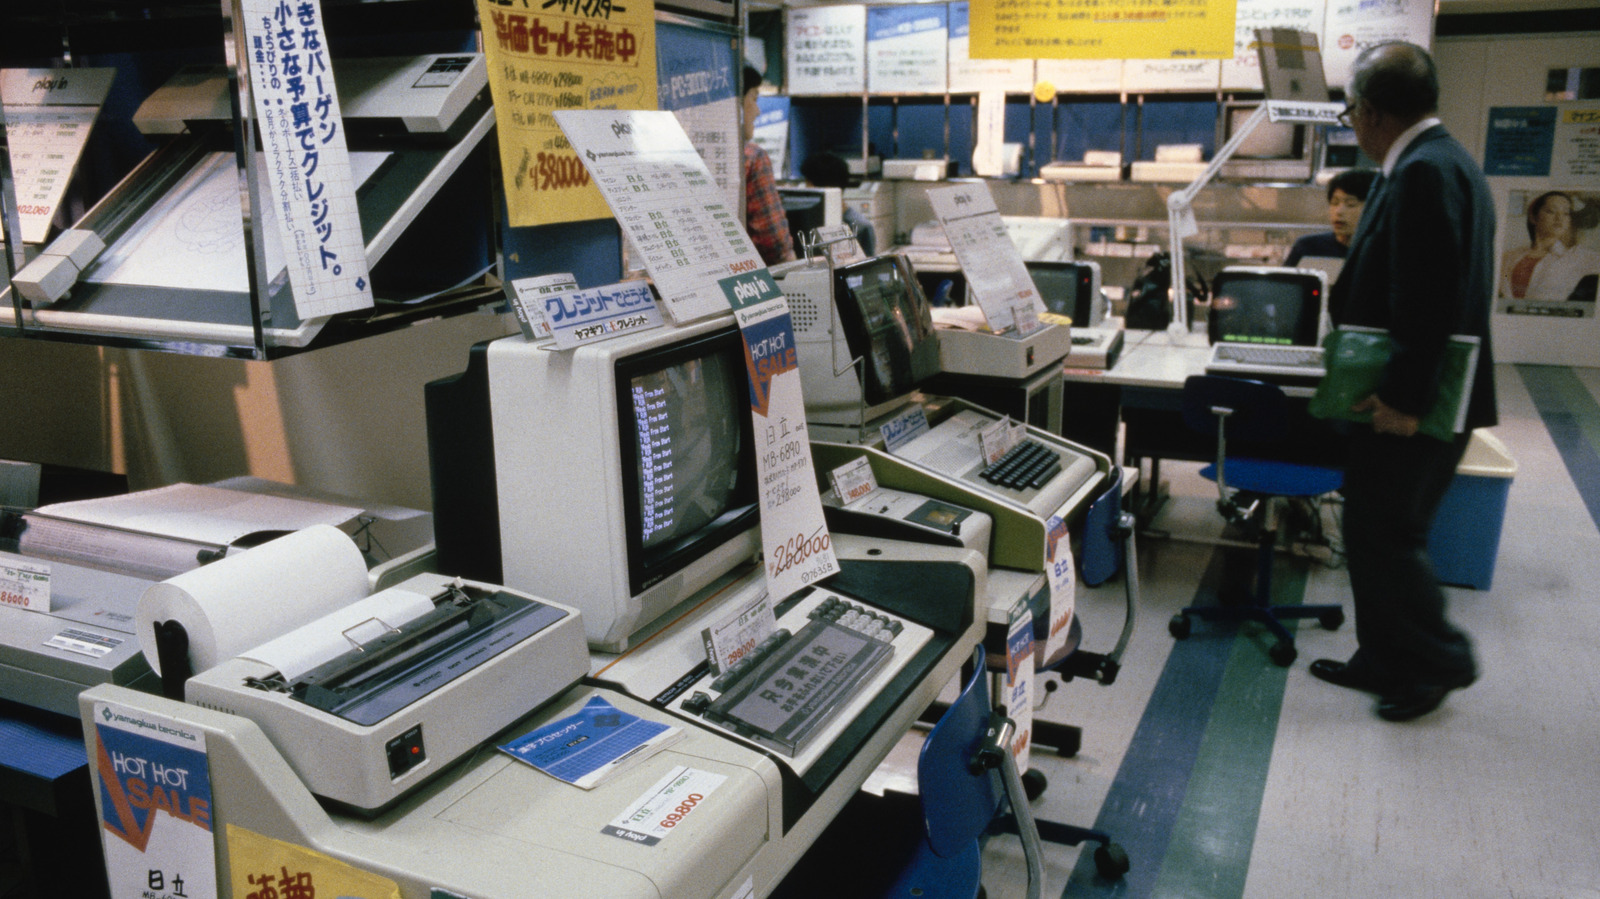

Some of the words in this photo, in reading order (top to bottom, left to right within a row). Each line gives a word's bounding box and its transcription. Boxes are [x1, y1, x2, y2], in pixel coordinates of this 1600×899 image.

[545, 286, 652, 323] クレジットでどうぞ
[733, 279, 761, 305] play
[754, 275, 770, 294] in
[751, 338, 769, 361] HOT
[769, 332, 786, 354] HOT
[757, 347, 797, 383] SALE
[112, 712, 157, 731] yamagiwa
[157, 723, 197, 742] tecnica
[112, 750, 148, 779] HOT
[152, 761, 189, 791] HOT
[126, 776, 211, 832] SALE
[660, 793, 704, 829] 69,800
